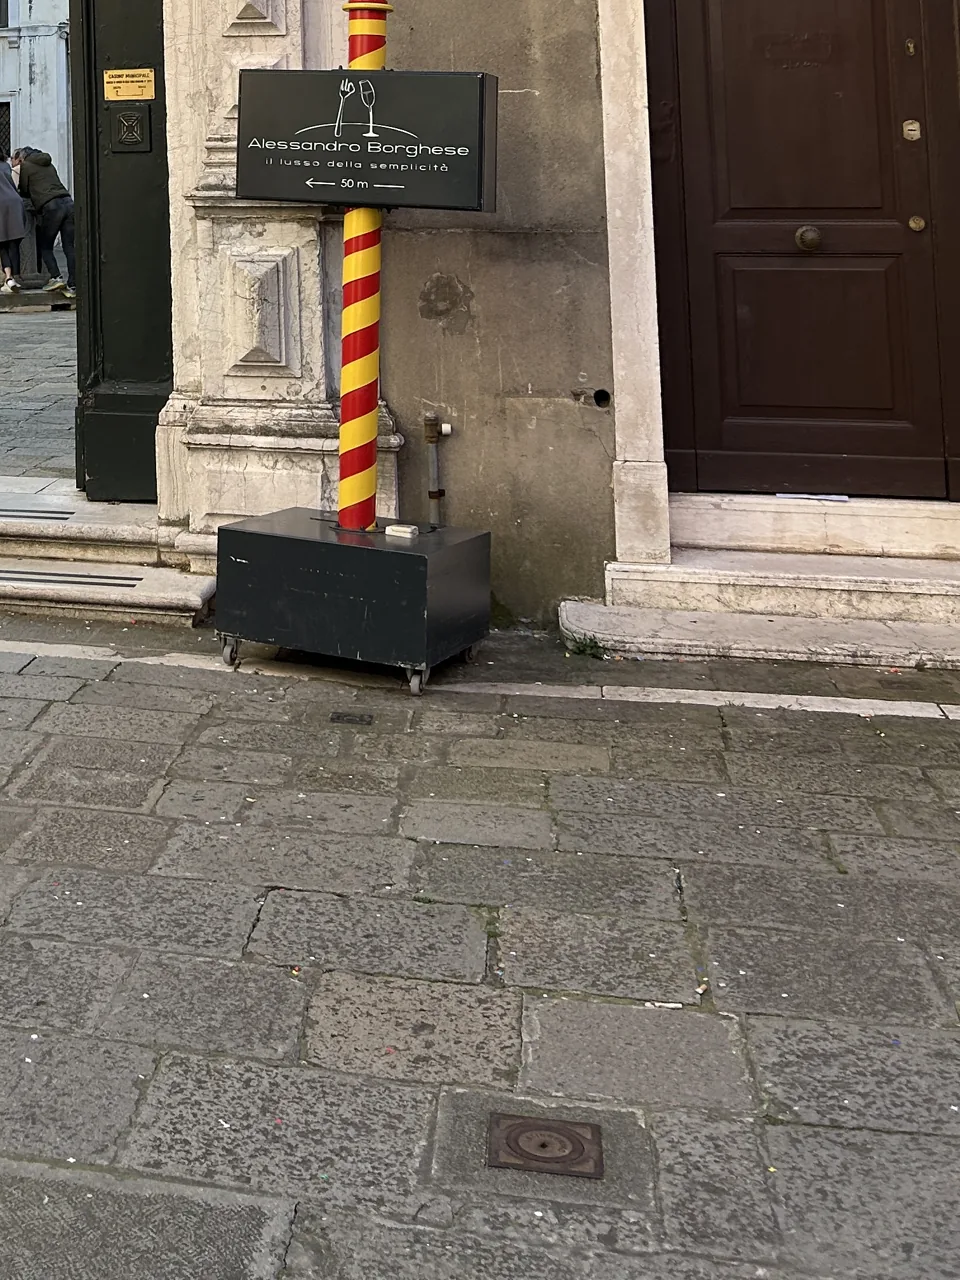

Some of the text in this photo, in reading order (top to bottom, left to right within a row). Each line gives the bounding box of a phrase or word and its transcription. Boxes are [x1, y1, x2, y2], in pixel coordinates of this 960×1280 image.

[247, 137, 470, 158] Alessandro Borghese
[265, 157, 449, 172] il lusso della semplicità
[340, 178, 369, 189] 50 m
